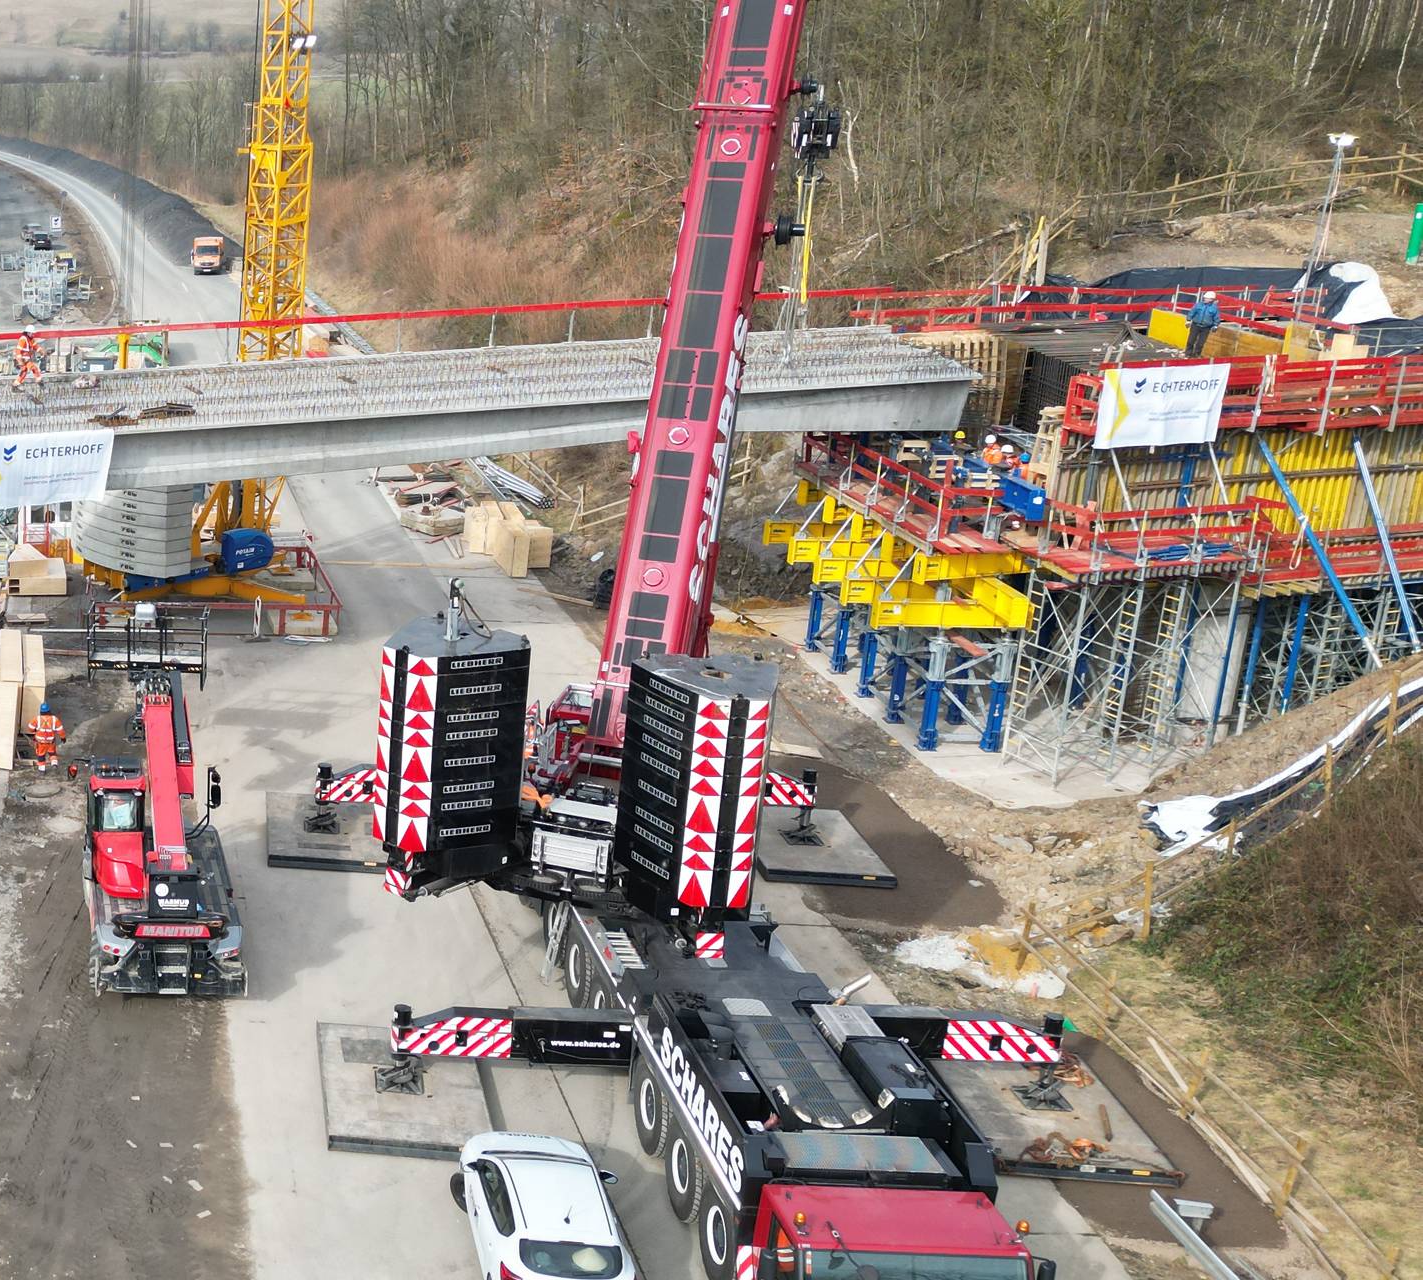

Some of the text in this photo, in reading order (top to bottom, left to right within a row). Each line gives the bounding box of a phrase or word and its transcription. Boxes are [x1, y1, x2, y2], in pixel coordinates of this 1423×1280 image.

[1152, 379, 1220, 393] ECHTERHOFF
[25, 444, 104, 459] ECHTERHOFF
[452, 658, 502, 668] LIEBHERR
[451, 685, 501, 695] LIEBHERR
[650, 679, 688, 703] LIEBHERR
[646, 697, 684, 721] LIEBHERR
[448, 711, 498, 722] LIEBHERR
[447, 729, 497, 740] LIEBHERR
[644, 715, 682, 740] LIEBHERR
[643, 734, 680, 759] LIEBHERR
[445, 756, 495, 767] LIEBHERR
[641, 753, 678, 778] LIEBHERR
[444, 782, 493, 792] LIEBHERR
[639, 780, 676, 806] LIEBHERR
[442, 800, 491, 810] LIEBHERR
[636, 807, 673, 833] LIEBHERR
[441, 825, 489, 836] LIEBHERR
[635, 825, 672, 852] LIEBHERR
[632, 852, 668, 879] LIEBHERR
[143, 926, 204, 937] MANITOU
[551, 1039, 621, 1049] www.schares.de
[660, 1026, 744, 1193] SCHARES
